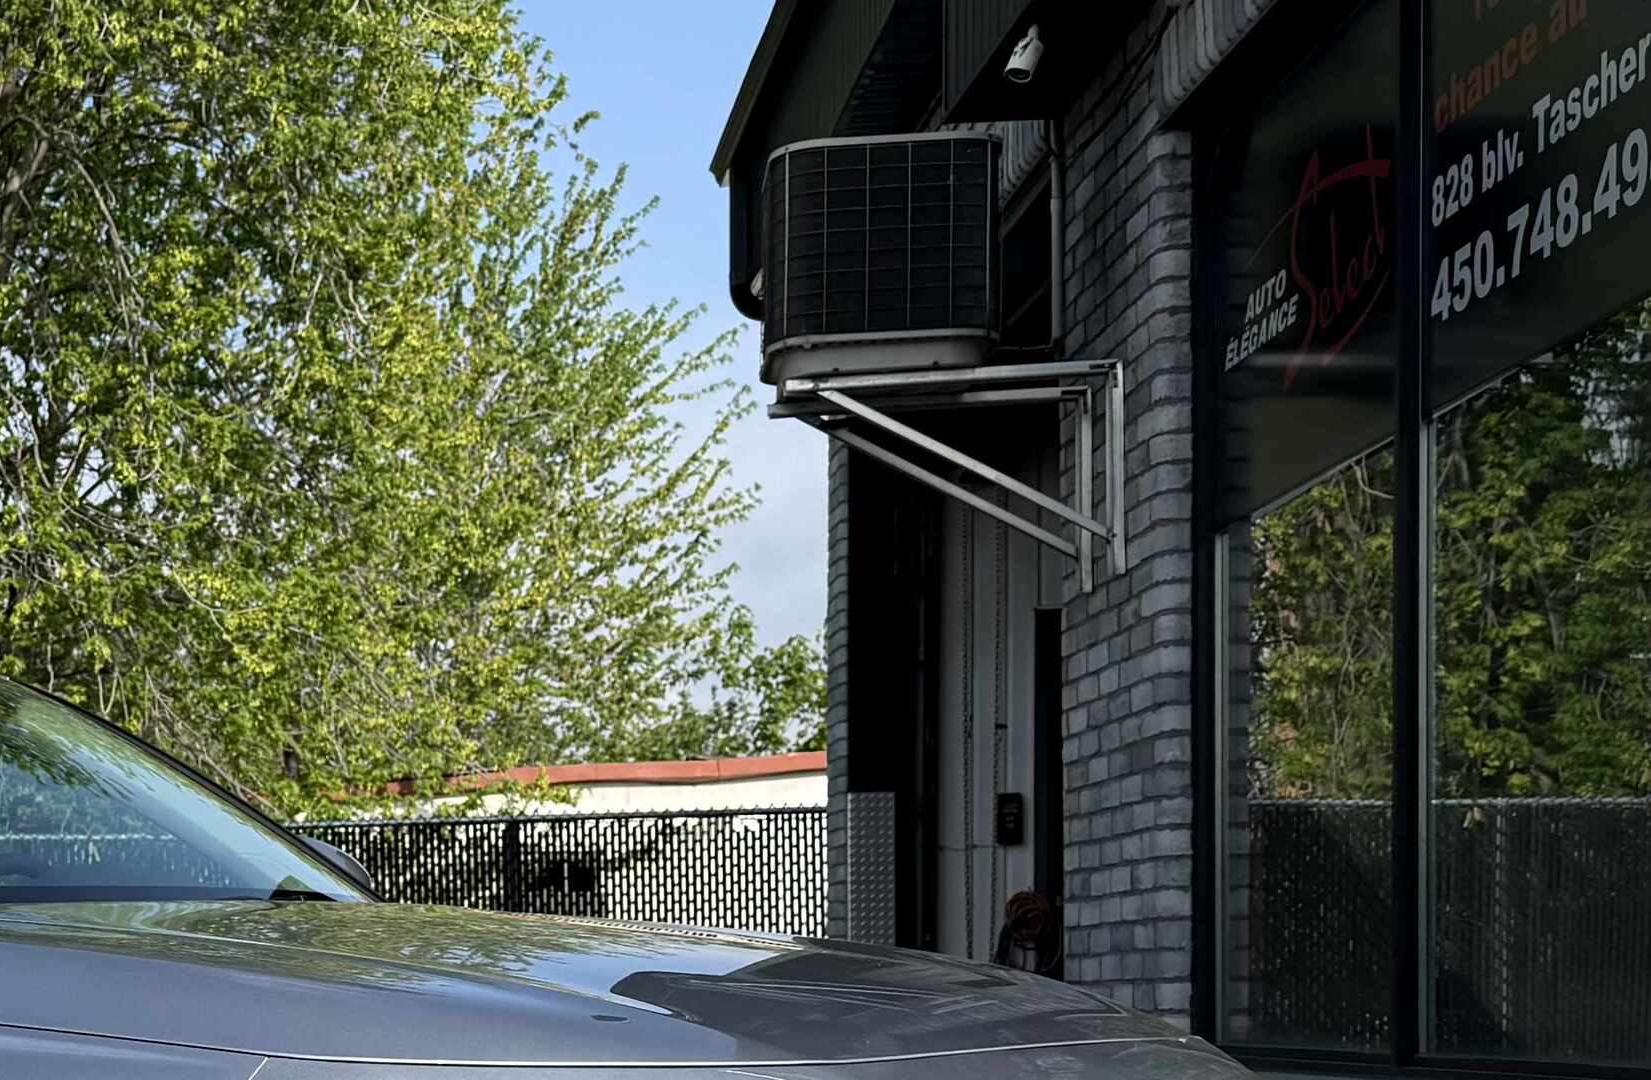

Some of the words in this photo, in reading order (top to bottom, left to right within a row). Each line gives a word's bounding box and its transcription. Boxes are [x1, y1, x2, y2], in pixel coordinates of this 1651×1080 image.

[1431, 152, 1475, 228] 828
[1482, 129, 1525, 194] blv.
[1532, 32, 1651, 153] Tascher
[1434, 22, 1538, 134] chance
[1430, 127, 1649, 322] 450.748.49
[1224, 292, 1299, 373] ÉLÉGANCE
[1245, 268, 1287, 323] AUTO
